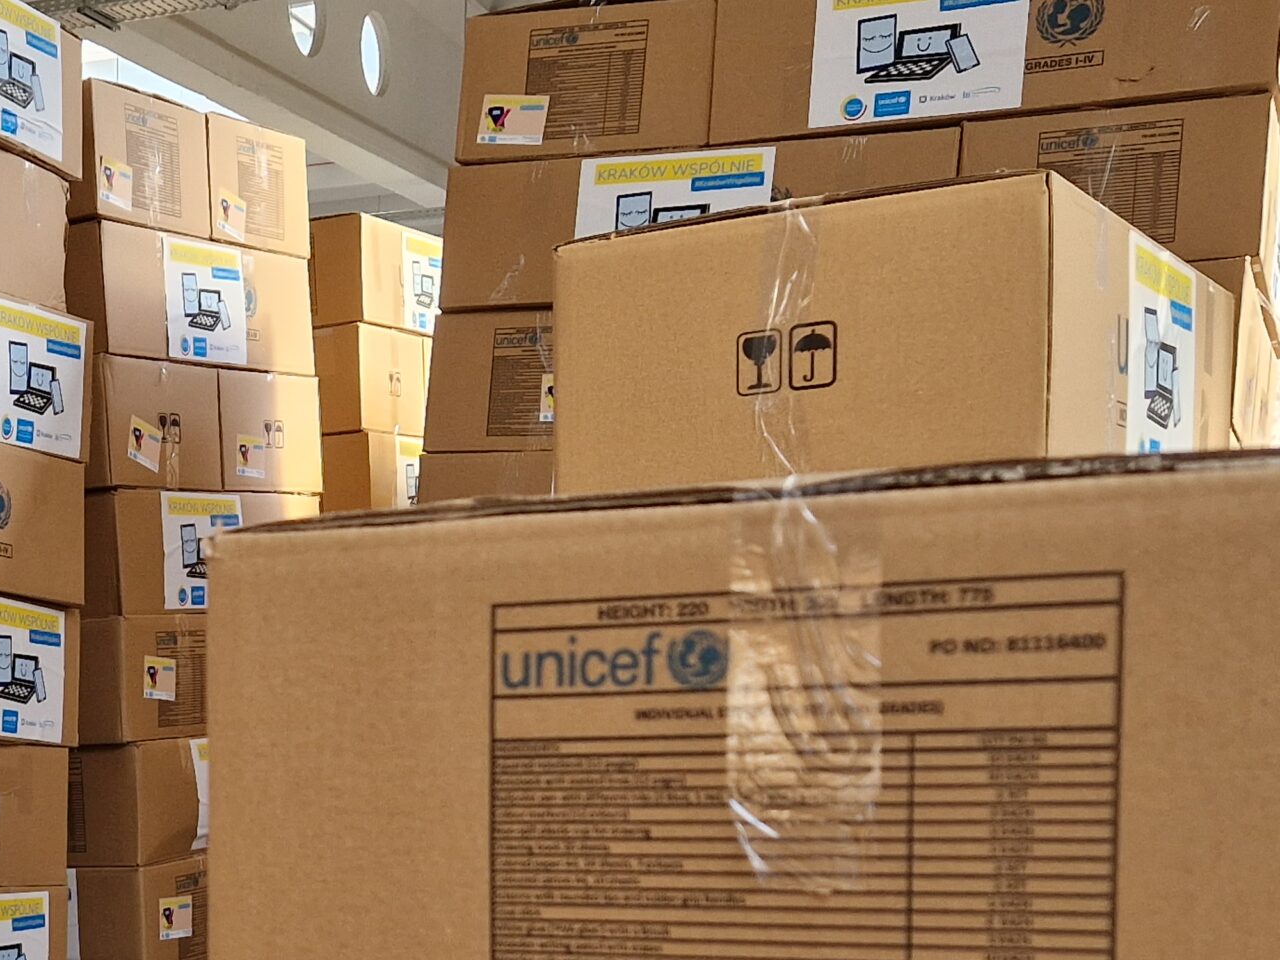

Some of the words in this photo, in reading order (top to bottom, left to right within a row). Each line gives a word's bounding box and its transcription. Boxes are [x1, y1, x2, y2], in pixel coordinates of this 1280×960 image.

[1026, 57, 1073, 71] GRADES
[598, 162, 667, 181] KRAKÓW
[671, 159, 756, 176] WSPÓLNIE
[496, 334, 529, 347] unicef
[597, 604, 669, 622] HEIGHT:
[676, 602, 709, 618] 220
[929, 638, 958, 655] PO
[502, 633, 662, 689] unicef
